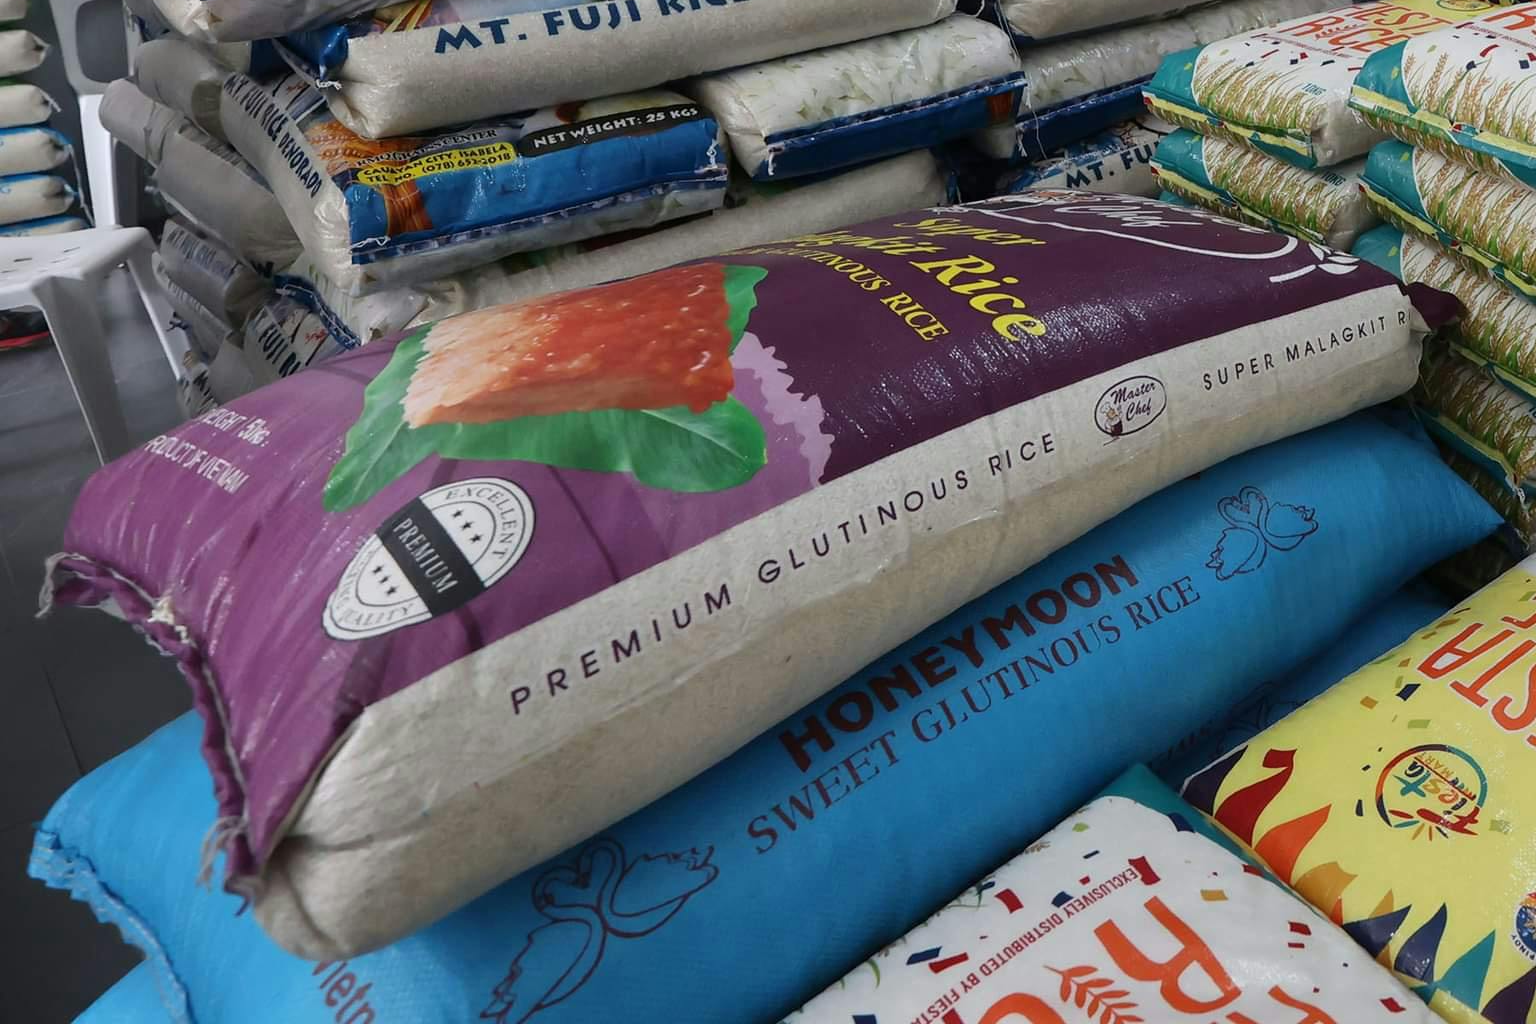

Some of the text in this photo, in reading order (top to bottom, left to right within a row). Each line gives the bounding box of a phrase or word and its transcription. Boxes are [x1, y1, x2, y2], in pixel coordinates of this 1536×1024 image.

[433, 17, 529, 55] MT.
[1303, 80, 1328, 98] 10KG
[458, 143, 508, 158] ISABELA
[532, 104, 700, 150] NET WEIGHT: 25 KGS
[278, 132, 322, 199] DENORADO
[422, 162, 455, 174] (078)
[457, 153, 512, 167] 652-2018
[1066, 161, 1115, 189] MT.
[893, 214, 1048, 250] Super
[880, 292, 951, 343] RICE
[910, 252, 1048, 343] Rice
[1200, 314, 1390, 392] SUPER MALAGKIT
[1109, 376, 1159, 408] Master
[1123, 399, 1155, 422] Chef
[444, 484, 511, 561] EXCELLENT
[392, 516, 459, 594] PREMIUM
[507, 430, 1058, 718] PREMIUM GLUTINOUS RICE
[775, 552, 1143, 774] HONEYMOON
[745, 573, 1204, 856] SWEET GLUTINOUS RICE
[1063, 865, 1141, 919] EXCLUSIVELY
[980, 911, 1064, 977] DISTRIBUTED
[960, 971, 981, 994] BY
